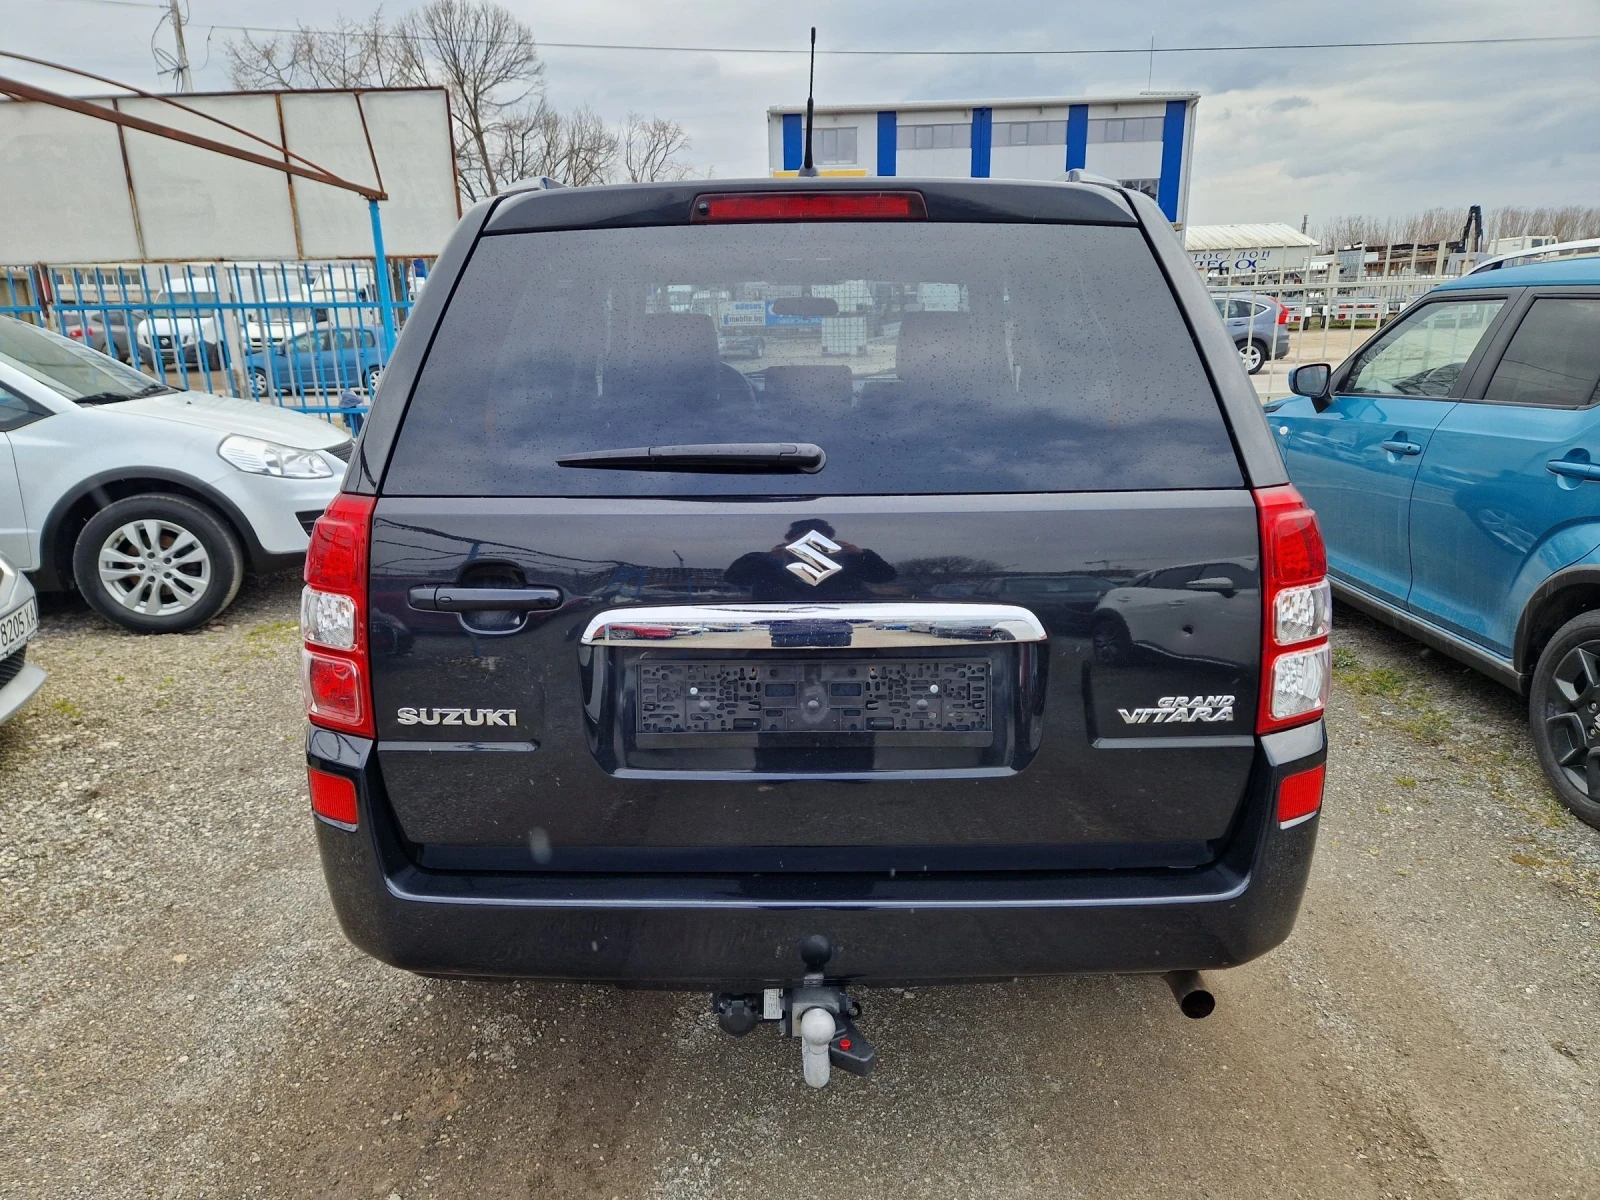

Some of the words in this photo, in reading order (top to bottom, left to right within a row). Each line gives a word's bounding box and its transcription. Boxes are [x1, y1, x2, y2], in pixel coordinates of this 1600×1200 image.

[0, 612, 25, 647] 8205
[1157, 695, 1236, 708] GRAND
[397, 707, 517, 726] SUZUKI
[1117, 706, 1235, 724] VITARA
